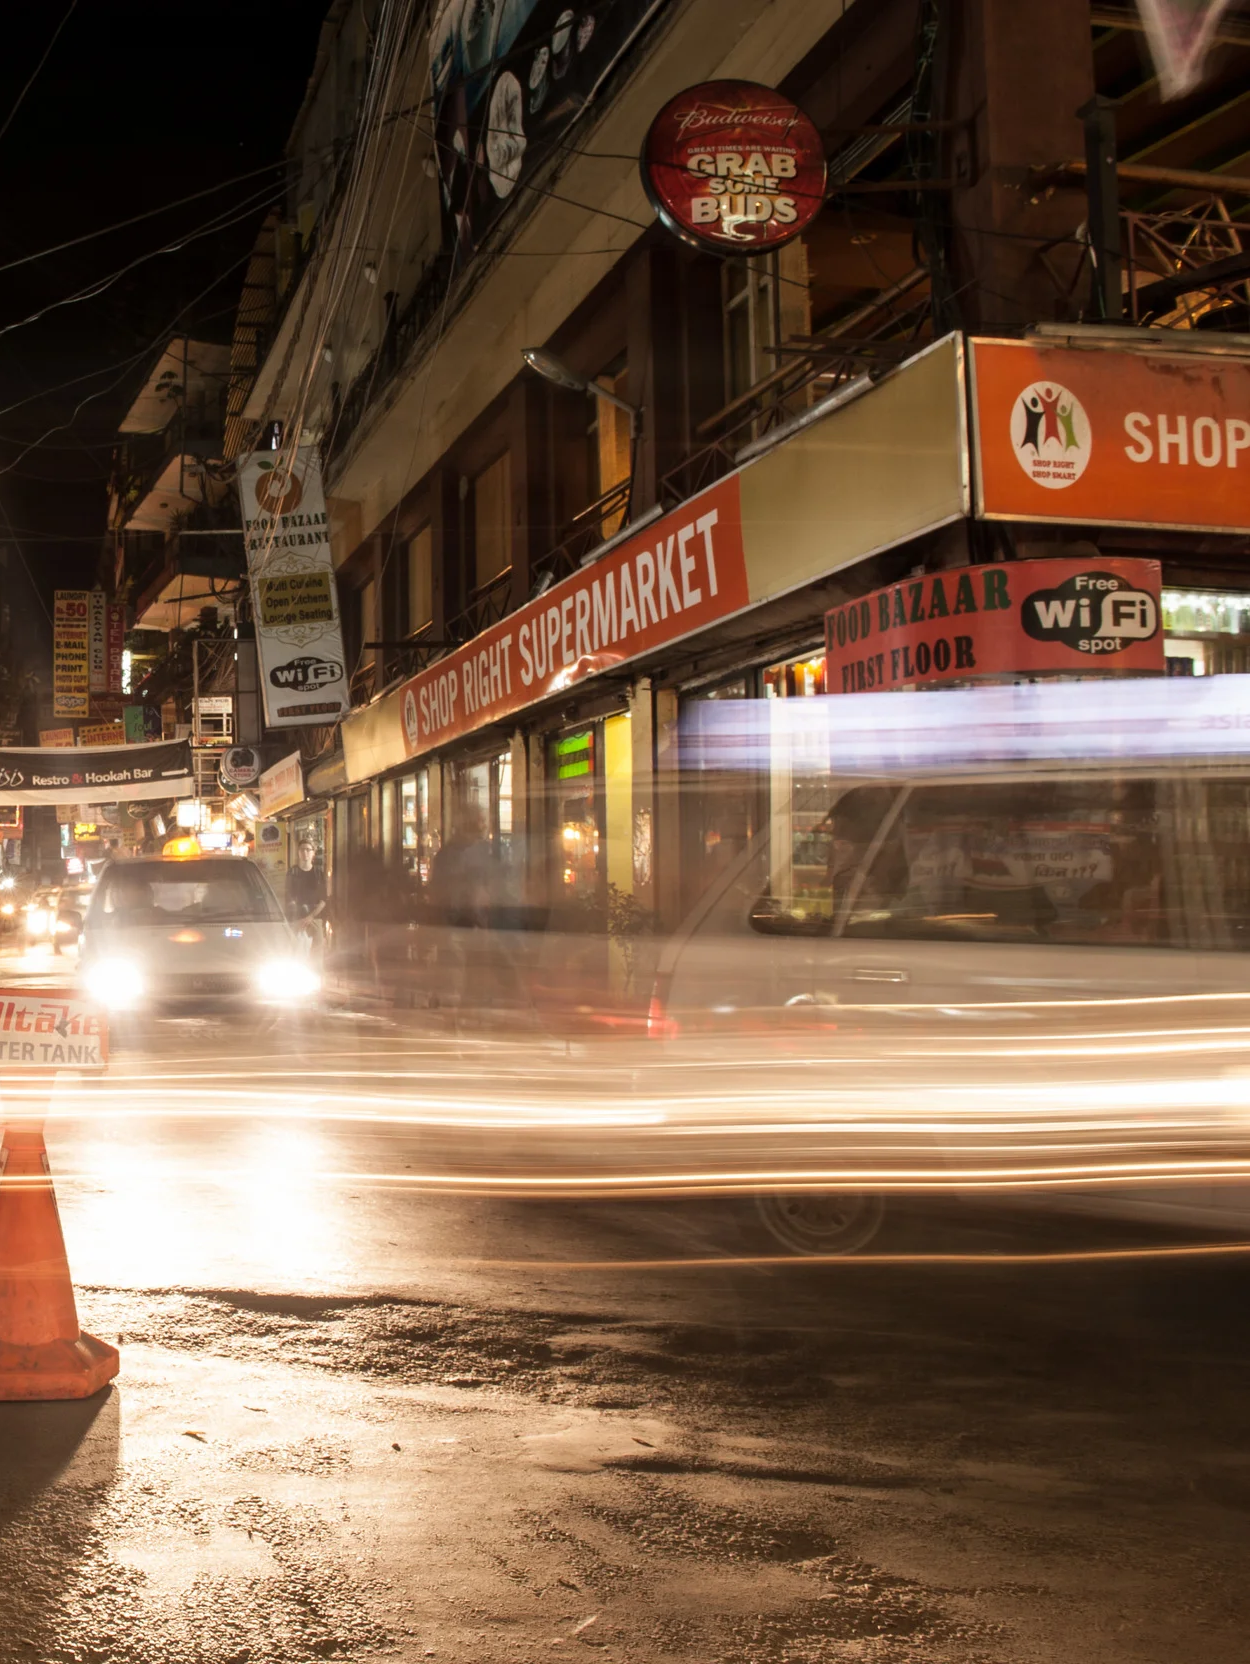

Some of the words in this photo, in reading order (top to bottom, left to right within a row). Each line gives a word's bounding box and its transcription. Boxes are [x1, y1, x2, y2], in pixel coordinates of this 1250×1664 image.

[673, 109, 800, 129] Budweiser
[687, 146, 716, 155] GREAT
[763, 147, 796, 155] WAITING
[686, 152, 798, 179] GRAB
[708, 177, 781, 195] SOME
[691, 195, 799, 224] BUDS
[1124, 411, 1250, 468] SHOP
[1032, 460, 1051, 468] SHOP
[1053, 461, 1075, 470] RIGHT
[1032, 471, 1051, 479] SHOP
[1052, 472, 1076, 480] SMART
[1075, 576, 1119, 591] Free
[265, 595, 291, 609] Open
[826, 601, 872, 652] FOOD
[878, 568, 1013, 634] BAZAAR
[298, 607, 333, 623] Seating
[419, 675, 459, 736] SHOP
[462, 633, 513, 715] RIGHT
[518, 508, 720, 686] SUPERMARKET
[55, 641, 86, 649] E-MAIL
[1078, 637, 1122, 653] spot
[55, 653, 87, 661] PHONE
[293, 657, 317, 667] Free
[841, 653, 885, 694] FIRST
[890, 635, 977, 682] FLOOR
[55, 664, 83, 672] PRINT
[297, 682, 322, 692] spot
[55, 695, 87, 708] skype
[32, 775, 70, 786] Restro
[71, 774, 83, 785] &
[85, 770, 131, 783] Hookah
[133, 768, 154, 779] Bar
[39, 1042, 99, 1064] TANK
